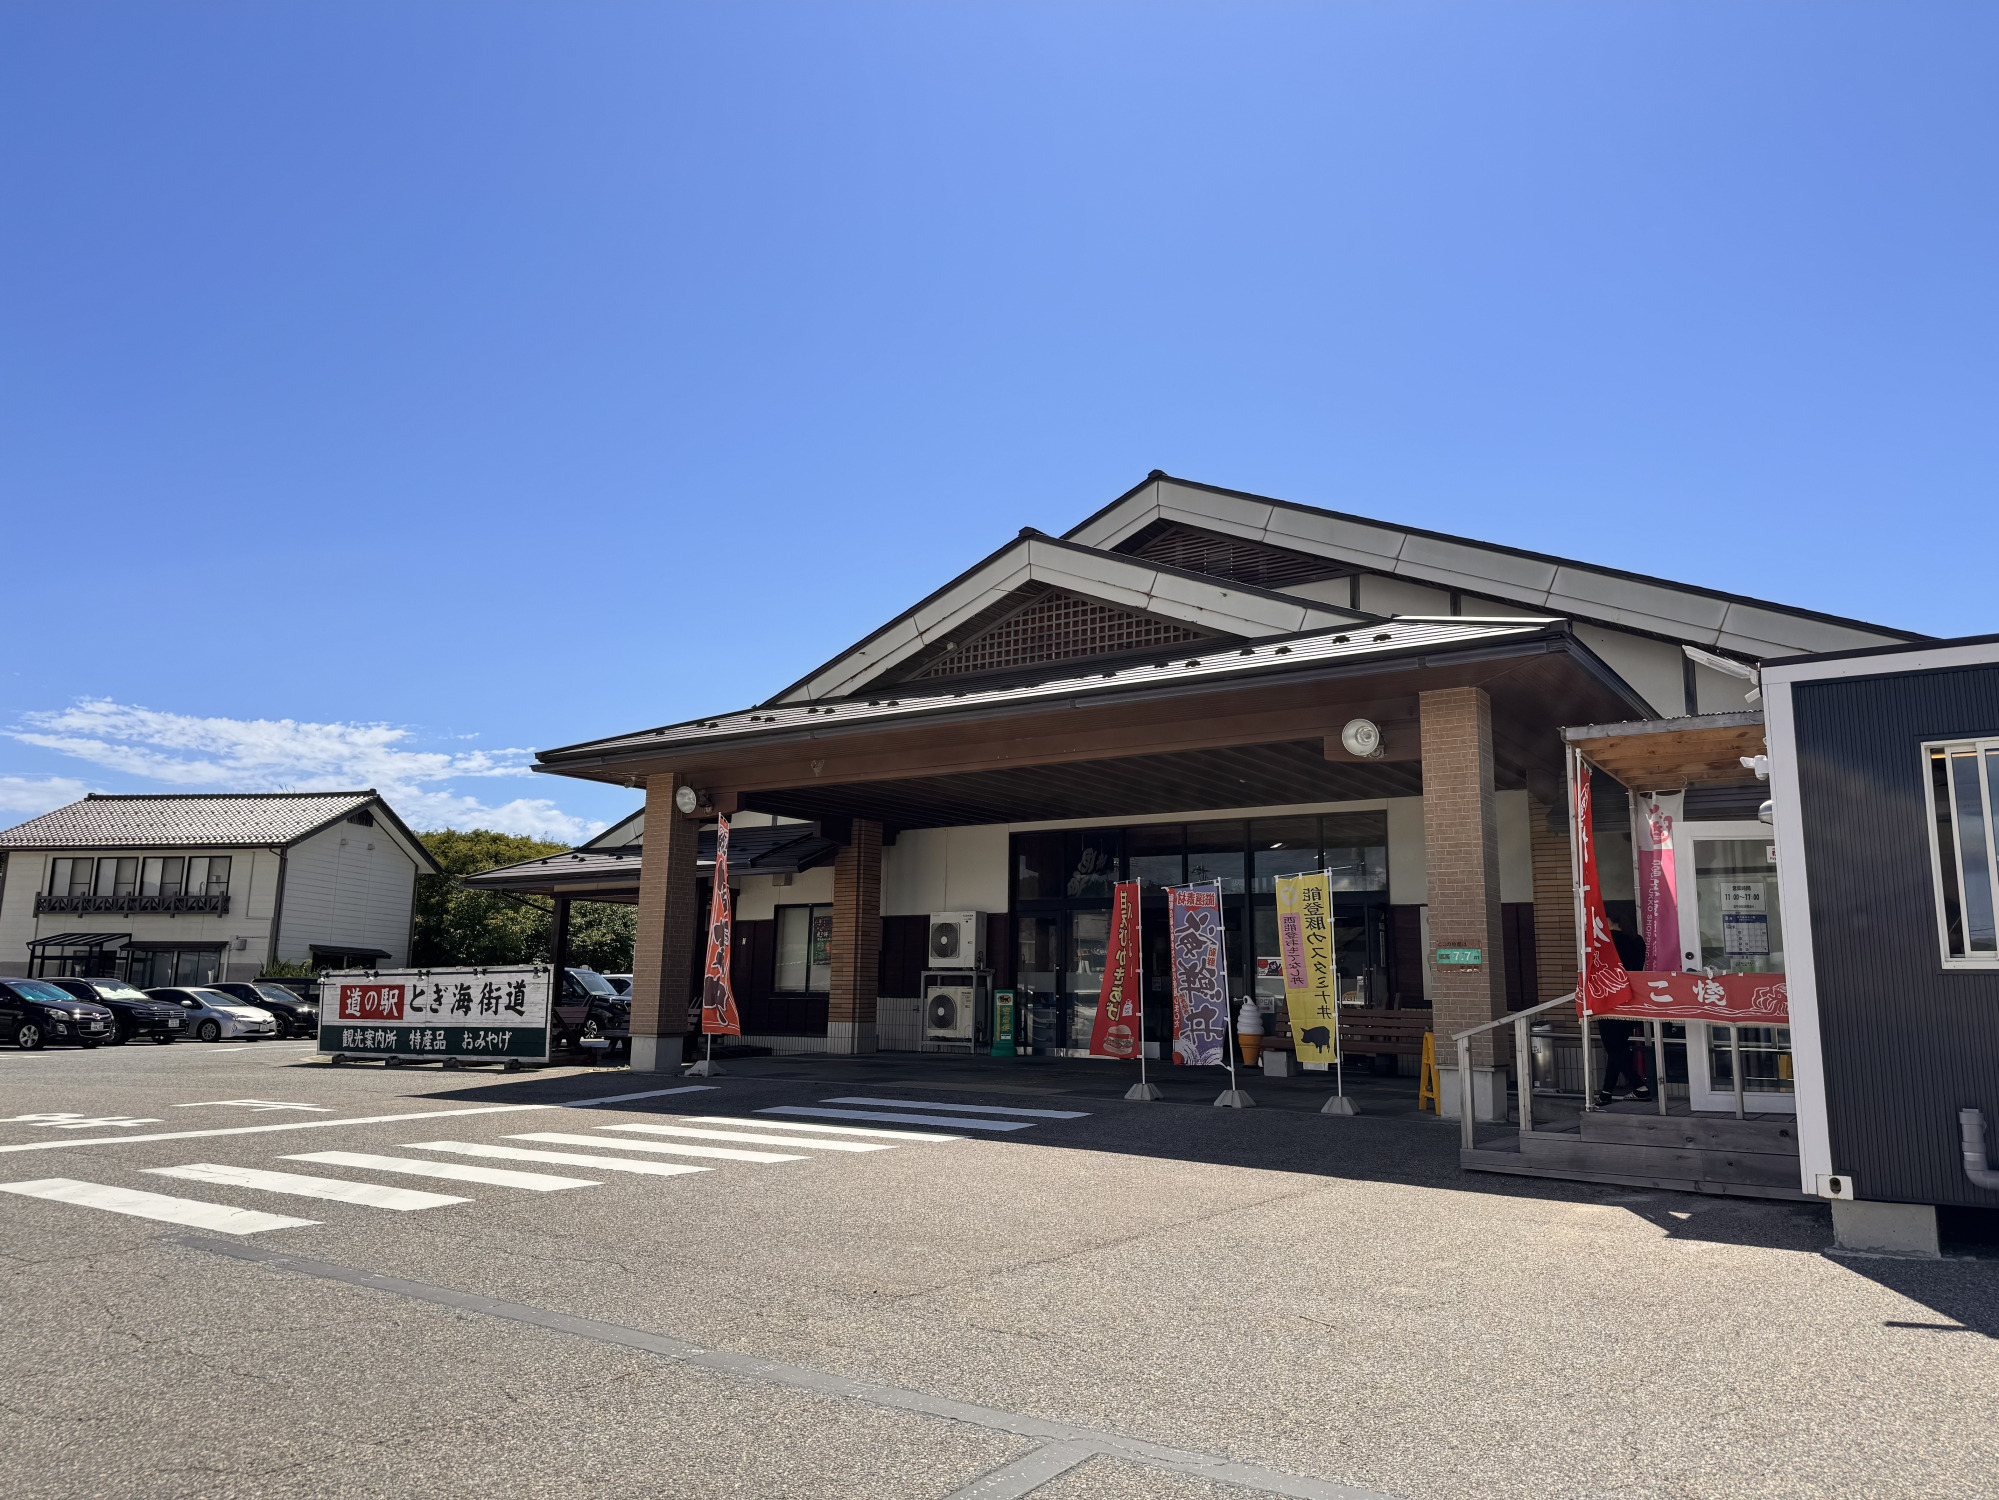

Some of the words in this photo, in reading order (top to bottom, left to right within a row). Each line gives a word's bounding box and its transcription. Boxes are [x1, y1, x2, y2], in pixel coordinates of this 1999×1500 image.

[1453, 951, 1471, 961] 7.7
[345, 988, 400, 1017] 道の駅
[409, 979, 527, 1017] とぎ海街道
[342, 1028, 398, 1049] 観光案内所
[409, 1029, 447, 1050] 特産品
[461, 1030, 513, 1052] おみやげ
